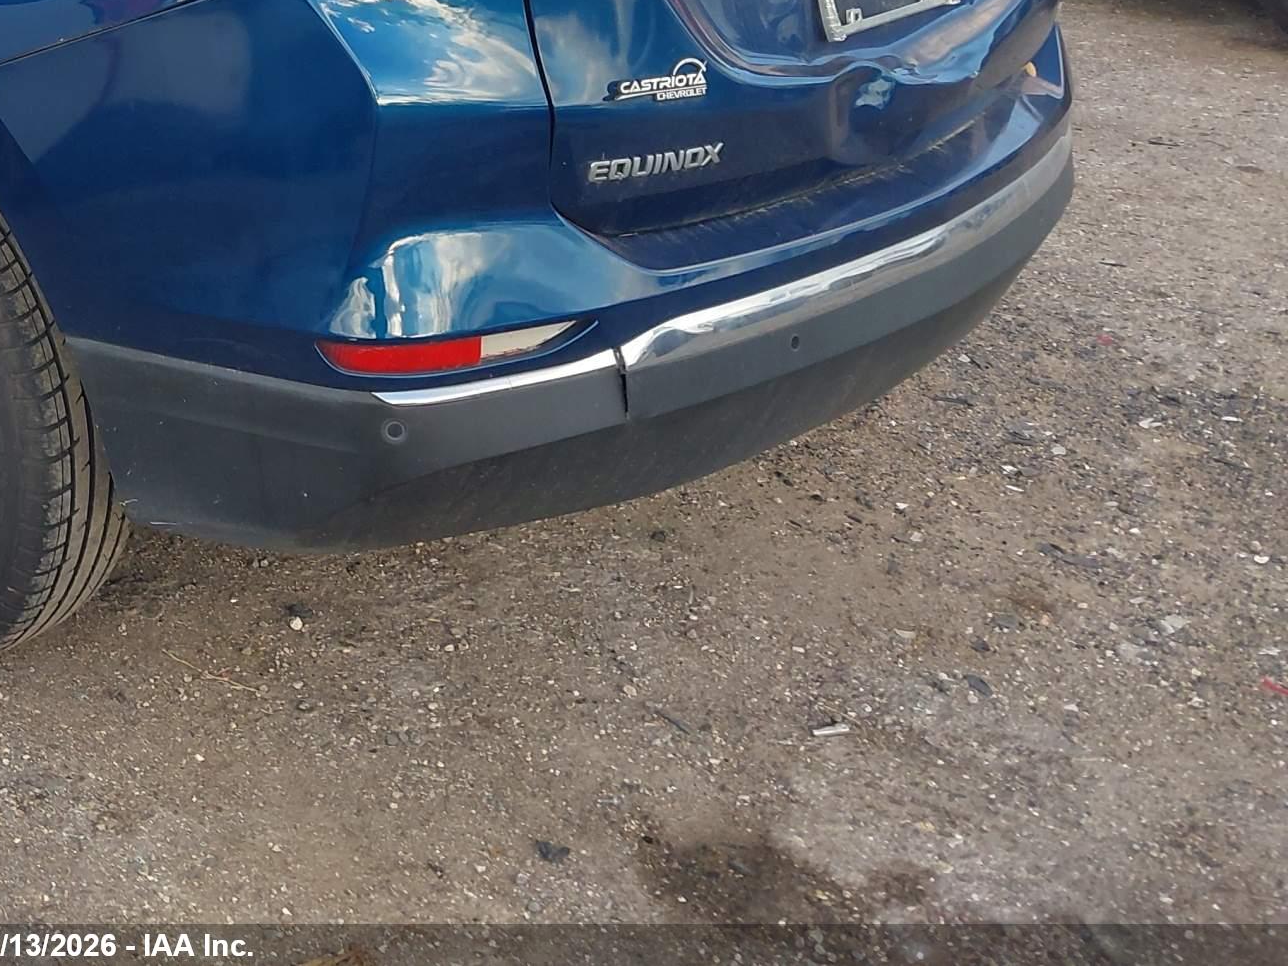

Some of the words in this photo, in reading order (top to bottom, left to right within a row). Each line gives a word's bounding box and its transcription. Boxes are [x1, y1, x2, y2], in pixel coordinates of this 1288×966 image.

[620, 71, 707, 94] CASTRIOTA
[656, 87, 707, 101] CHEVROLET
[588, 142, 724, 182] EQUINOX
